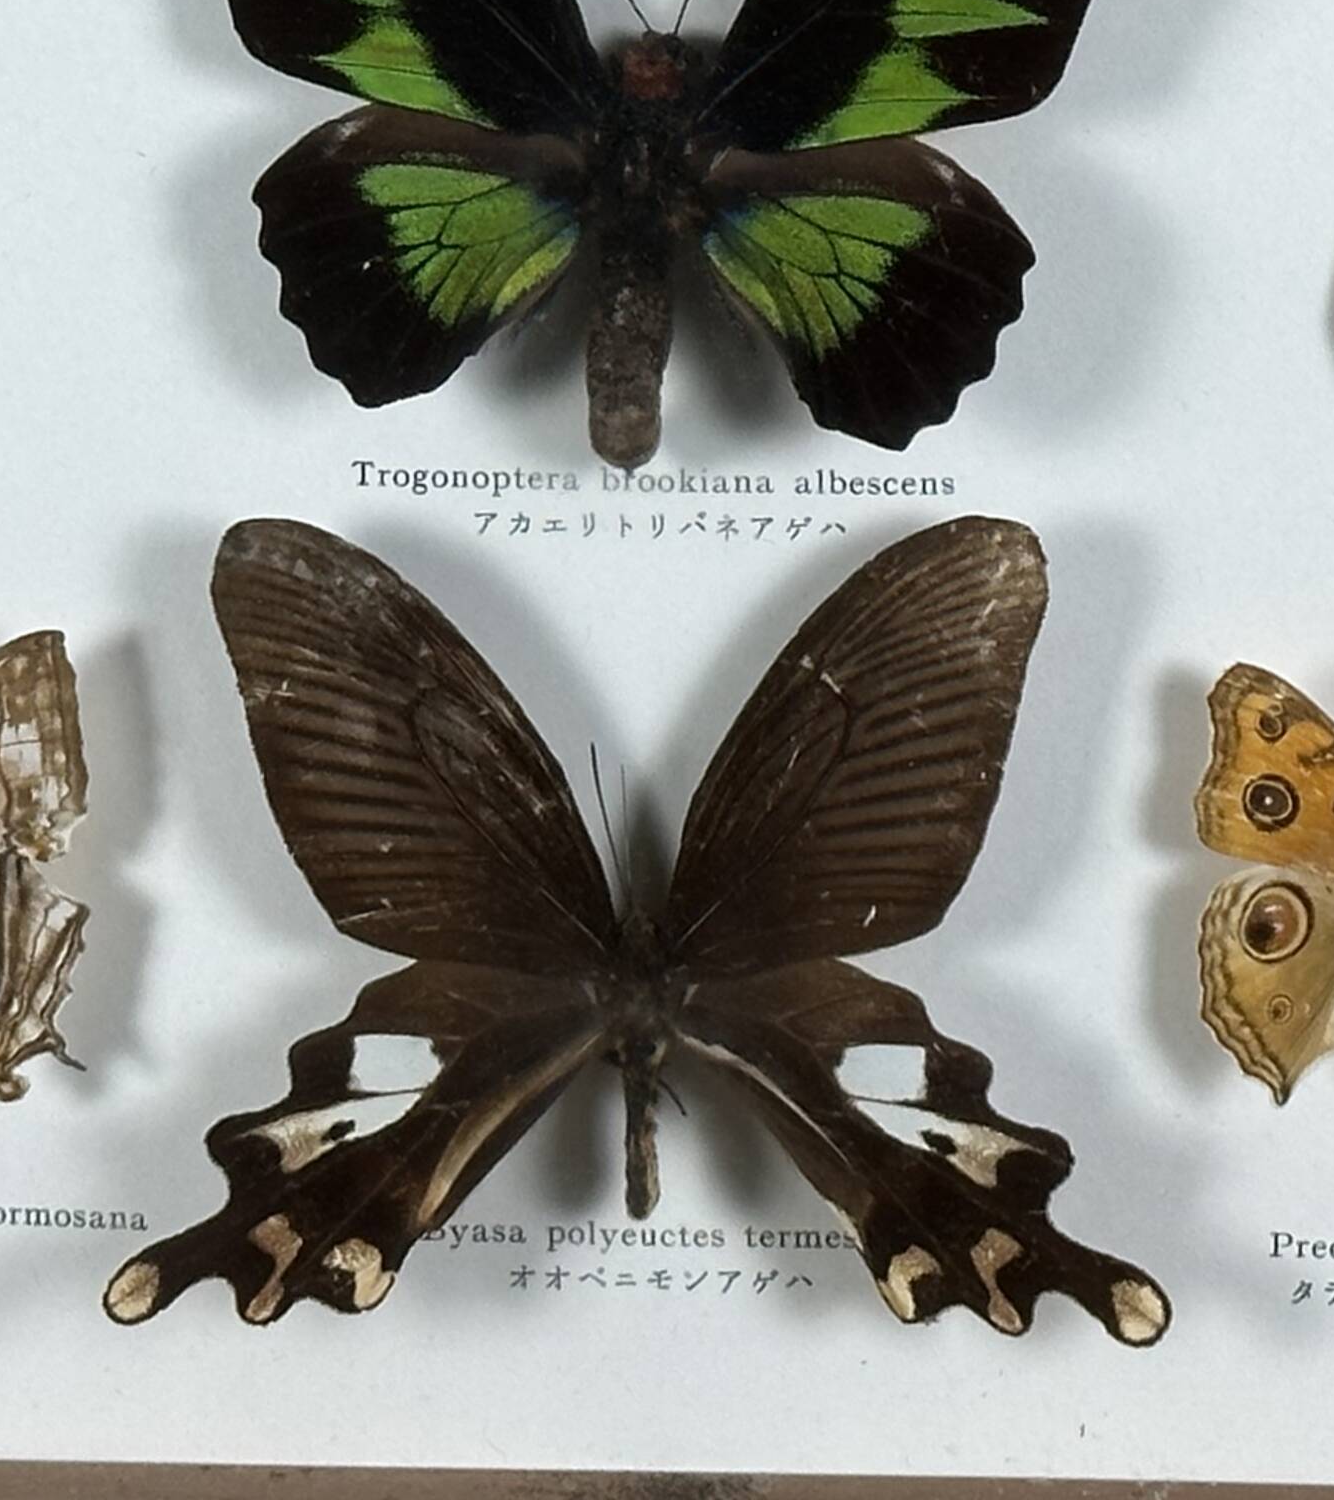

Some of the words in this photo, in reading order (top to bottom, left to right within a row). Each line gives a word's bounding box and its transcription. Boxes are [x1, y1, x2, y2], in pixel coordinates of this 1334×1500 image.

[350, 459, 581, 499] Trogonoptera
[601, 467, 775, 495] brookiana
[793, 468, 956, 497] albescens
[546, 1215, 726, 1255] polyeuctes
